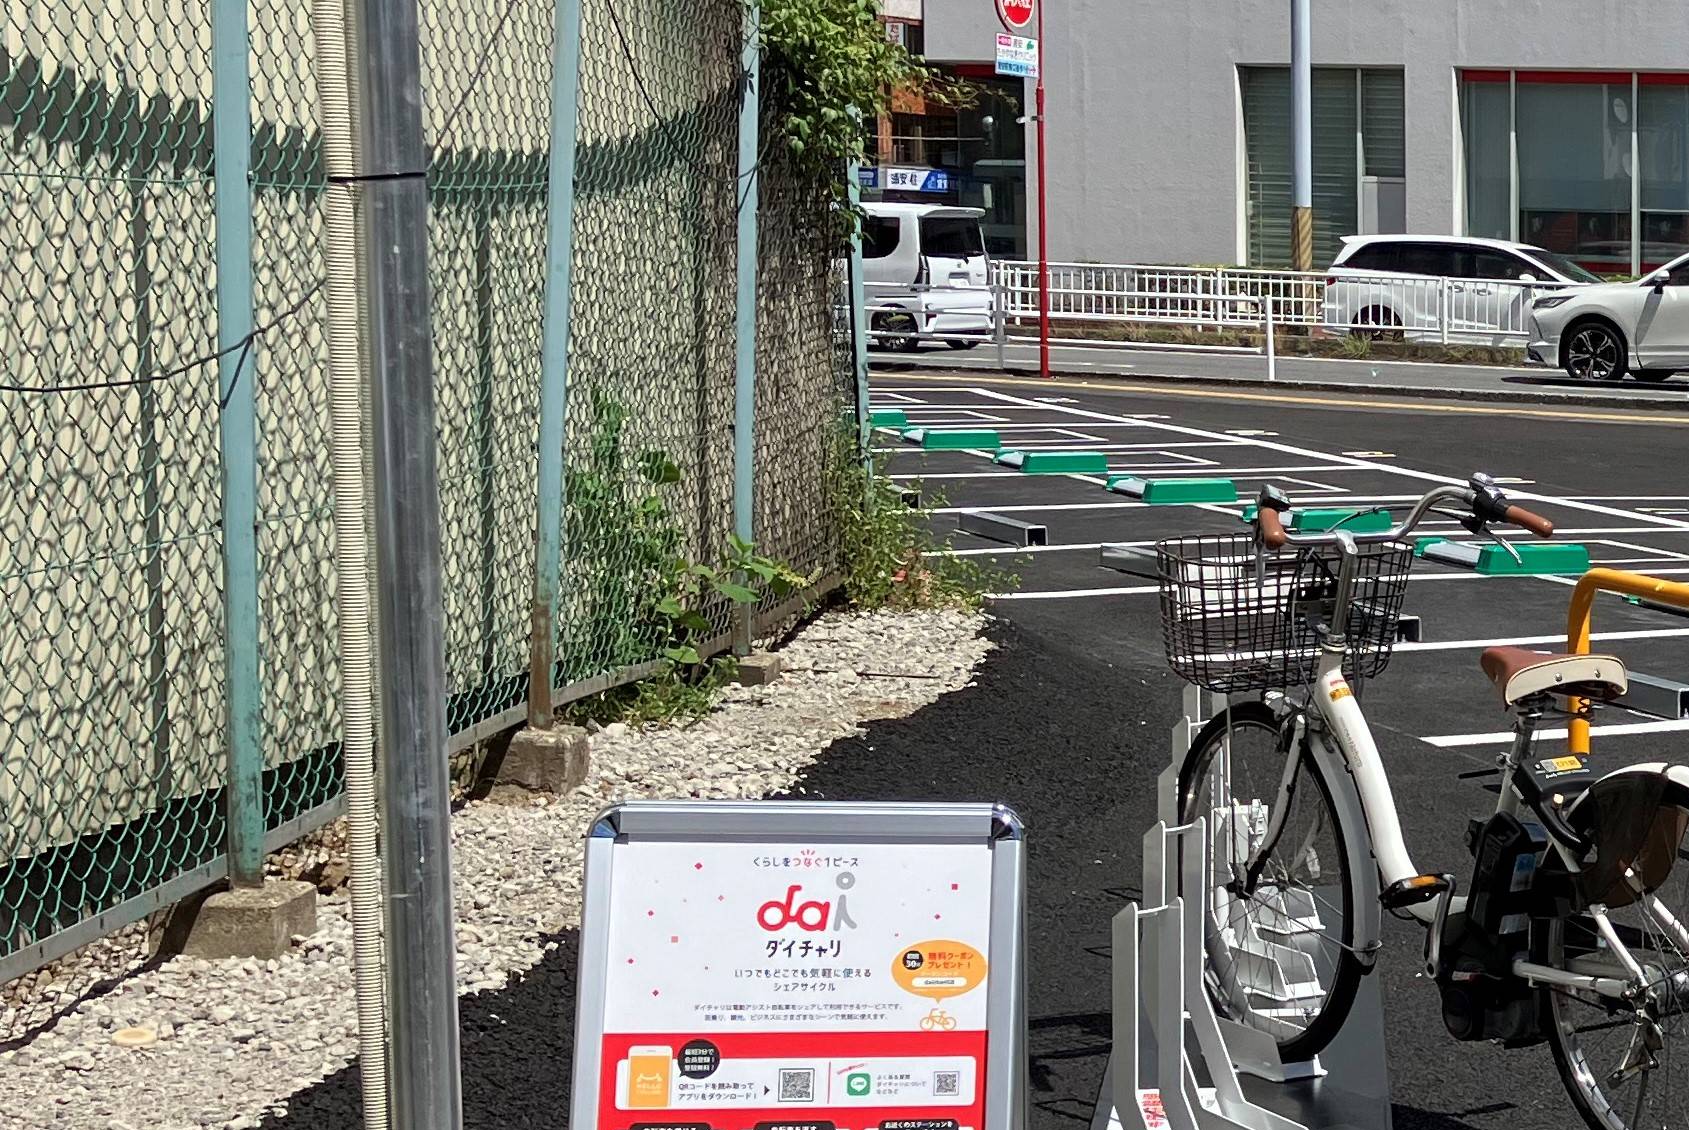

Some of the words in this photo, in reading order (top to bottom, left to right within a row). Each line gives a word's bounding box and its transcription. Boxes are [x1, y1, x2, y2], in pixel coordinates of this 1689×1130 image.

[753, 856, 859, 868] くらしをつなぐ1ピース
[765, 938, 842, 959] ダイチャリ
[928, 951, 974, 961] 無料クーポン
[734, 967, 872, 979] いつでもどこでも気軽に使える
[773, 982, 836, 992] シェアサイクル
[678, 1082, 755, 1092] QRコードを読み取って
